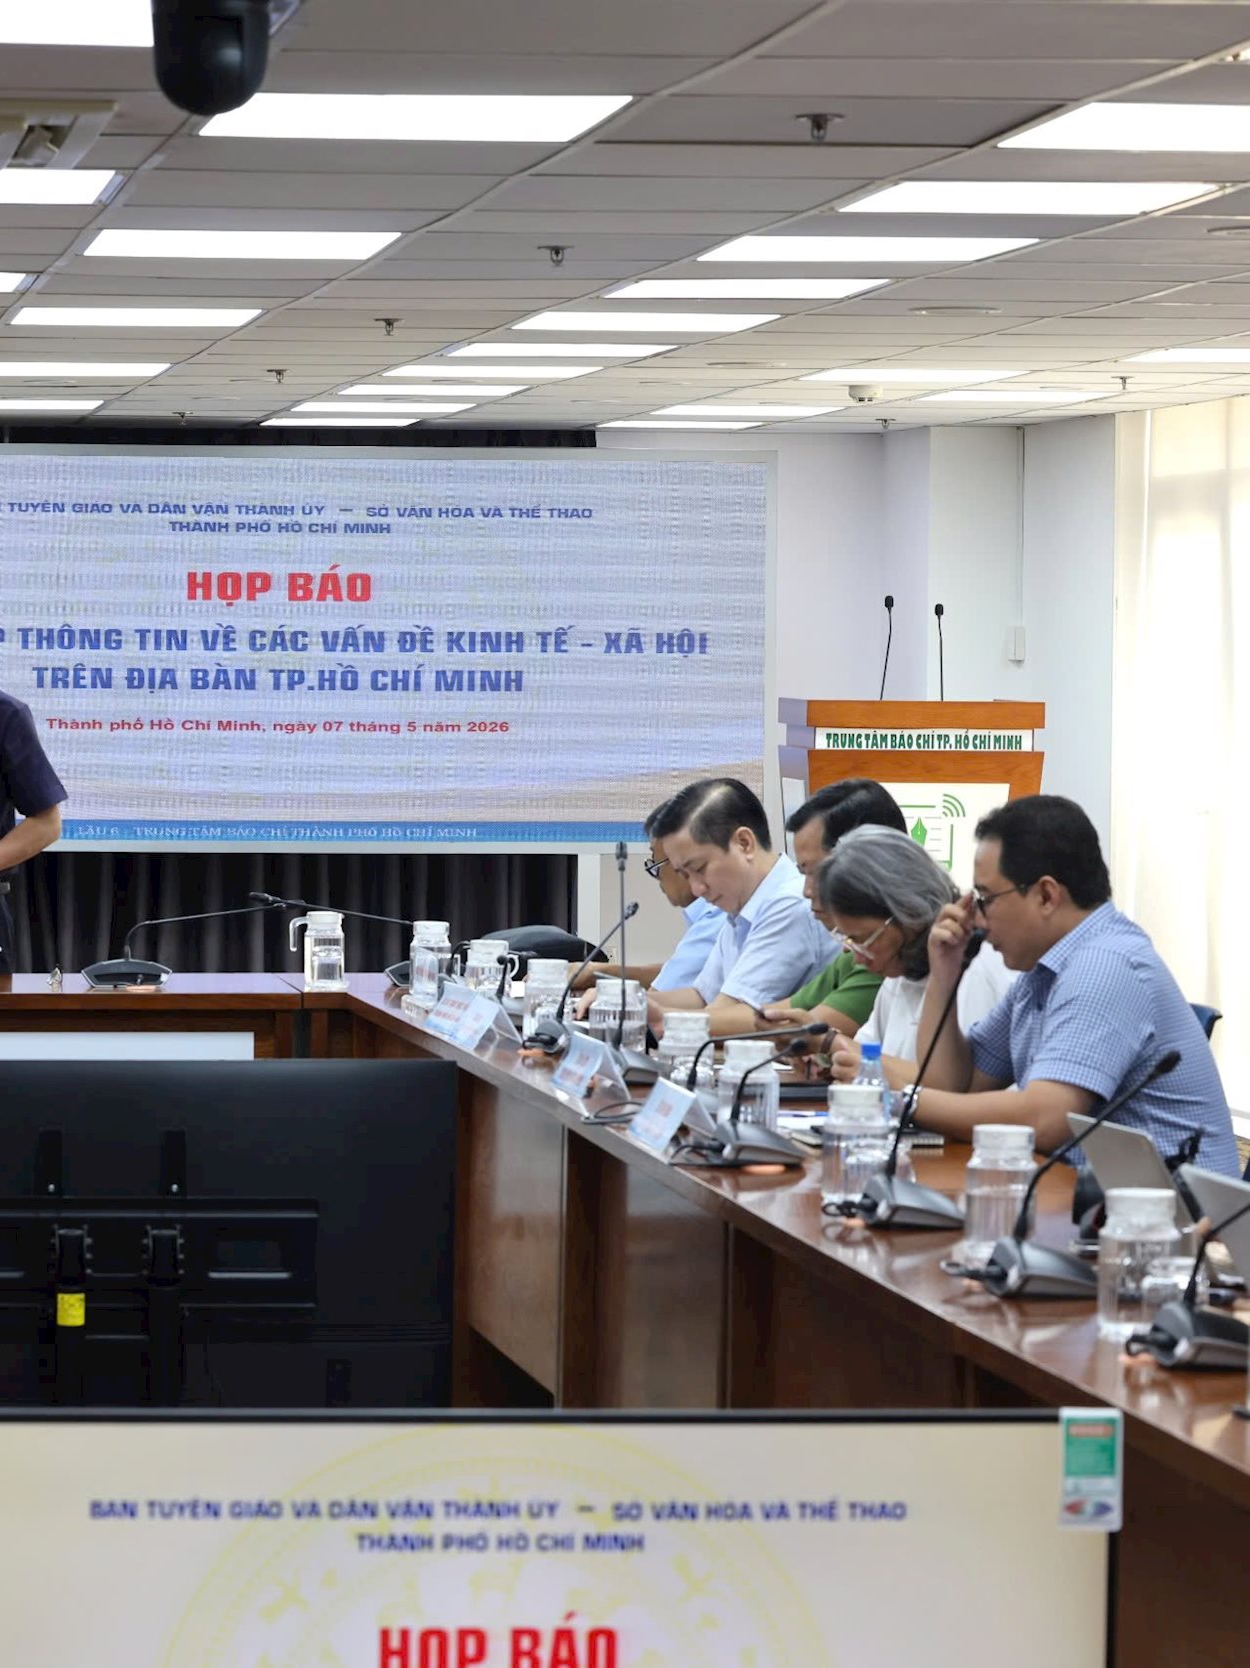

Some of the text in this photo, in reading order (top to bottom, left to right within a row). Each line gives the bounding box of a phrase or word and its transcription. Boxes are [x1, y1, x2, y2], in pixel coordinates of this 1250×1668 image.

[7, 499, 66, 513] TUYÊN
[71, 500, 113, 514] GIÁO
[148, 501, 187, 515] DÂN
[191, 501, 229, 517] VẬN
[480, 505, 504, 518] VÀ
[547, 507, 593, 519] THAO
[169, 518, 391, 534] THÀNH PHỐ HỒ CHÍ MINH
[187, 564, 372, 607] HỌP BÁO
[18, 624, 123, 651] THÔNG
[134, 629, 188, 651] TIN
[199, 622, 238, 652] VỀ
[248, 625, 309, 652] CÁC
[320, 624, 385, 653] VẤN
[396, 625, 435, 653] ĐỀ
[447, 630, 525, 653] KINH
[536, 625, 574, 654] TẾ
[604, 628, 645, 654] XÃ
[655, 628, 707, 658] HỘI
[33, 662, 523, 694] TRÊN ĐỊA BÀN TP.HỒ CHÍ MINH
[47, 717, 509, 734] Thành phố Hồ Chí Minh, ngày 07 tháng 5 năm 2026
[826, 733, 862, 748] TRUNG
[864, 731, 888, 749] TÂM
[890, 730, 914, 749] BÁO
[915, 731, 935, 749] CHÍ
[937, 734, 952, 750] TP.
[972, 731, 991, 750] CHÍ
[993, 735, 1022, 750] MINH
[134, 827, 186, 836] TRUNG
[437, 828, 478, 837] MINH
[90, 1500, 138, 1520] BAN
[148, 1500, 223, 1520] TUYÊN
[328, 1499, 378, 1520] DÂN
[849, 1501, 907, 1521] THAO
[583, 1532, 646, 1552] MINH
[510, 1610, 618, 1668] BÁO
